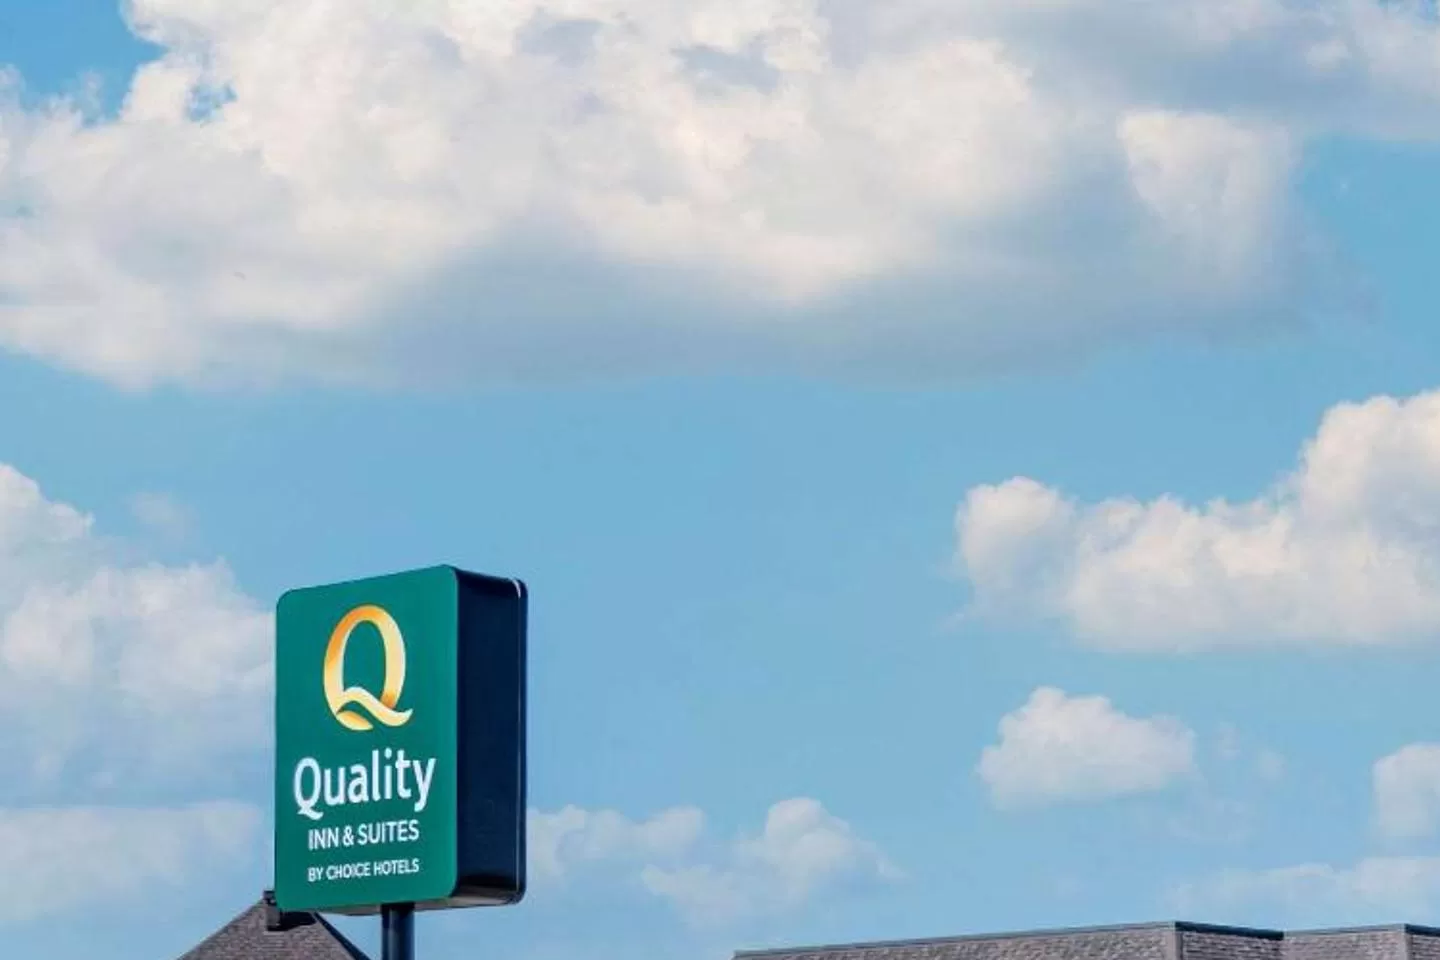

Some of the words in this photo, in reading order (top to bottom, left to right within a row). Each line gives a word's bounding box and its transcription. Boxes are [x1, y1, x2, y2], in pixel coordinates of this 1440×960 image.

[323, 604, 414, 731] Q
[293, 747, 437, 820] Quality
[308, 826, 339, 851] INN
[342, 825, 354, 847] &
[357, 819, 420, 845] SUITES
[308, 866, 324, 882] BY
[326, 861, 371, 880] CHOICE
[373, 858, 420, 876] HOTELS
